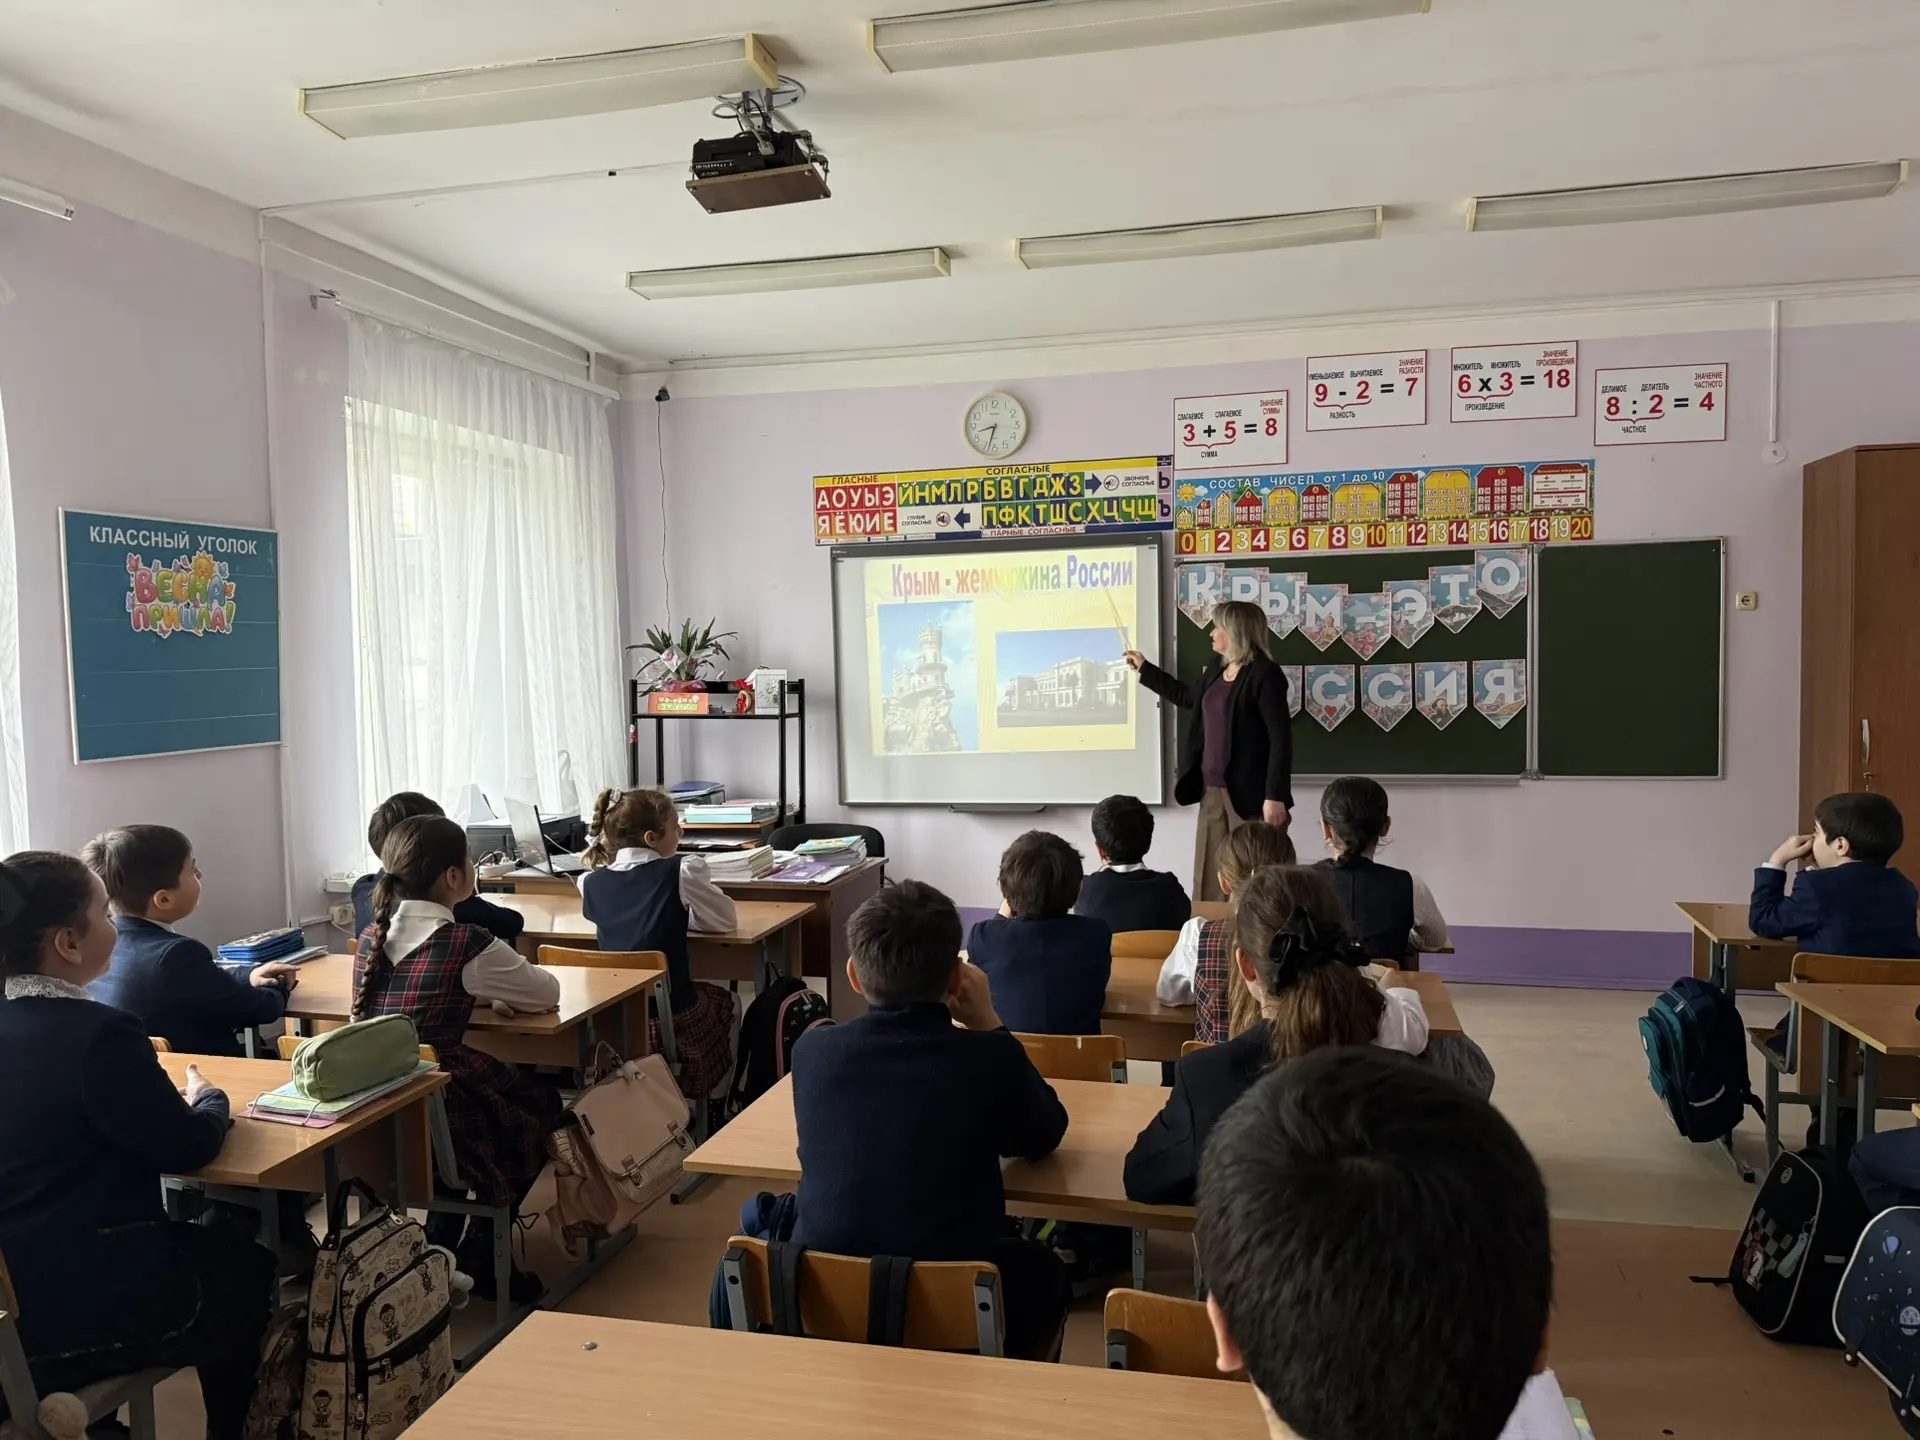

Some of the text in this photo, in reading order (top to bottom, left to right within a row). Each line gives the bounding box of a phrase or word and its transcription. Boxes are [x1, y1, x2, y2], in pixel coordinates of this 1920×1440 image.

[1543, 349, 1568, 357] ЗНАЧЕНИЕ
[1399, 358, 1424, 367] ЗНАЧЕНИЕ
[1453, 360, 1521, 371] МНОЖИТЕЛЬ МНОЖИТЕЛЬ
[1536, 357, 1575, 366] ПРОИЗВЕДЕНИЯ
[1308, 368, 1383, 381] УМЕНЬШАЕМОЕ ВЫЧИТАЕМОЕ
[1399, 366, 1424, 375] РАЗНОСТИ
[1694, 371, 1723, 380] ЗНАЧЕНИЕ
[1457, 373, 1471, 393] 6
[1499, 371, 1513, 391] 3
[1543, 368, 1570, 389] 18
[1694, 380, 1723, 389] ЧАСТНОГО
[1314, 383, 1328, 402] 9
[1356, 380, 1369, 400] 2
[1405, 377, 1419, 396] 7
[1601, 382, 1669, 394] ДЕЛИМОЕ ДЕЛИТЕЛЬ
[992, 400, 999, 408] 12
[1004, 401, 1007, 409] 1
[1260, 398, 1283, 407] ЗНАЧЕНИЕ
[1465, 401, 1505, 411] ПРОИЗВЕДЕНИЕ
[1606, 396, 1620, 416] 8
[1648, 394, 1663, 414] 2
[1699, 391, 1714, 411] 4
[981, 403, 987, 412] 11
[1262, 406, 1280, 415] СУММЫ
[973, 412, 981, 420] 10
[1010, 409, 1016, 418] 2
[1178, 409, 1242, 421] СЛАГАЕМОЕ СЛАГАЕМОЕ
[1329, 410, 1355, 419] РАЗНОСТЬ
[970, 423, 976, 432] 9
[1014, 421, 1020, 429] 3
[1183, 423, 1195, 441] 3
[1224, 420, 1236, 439] 5
[1265, 417, 1277, 436] 8
[1622, 424, 1646, 434] ЧАСТНОЕ
[974, 434, 980, 443] 8
[1010, 432, 1016, 440] 4
[983, 441, 988, 449] 7
[992, 444, 998, 452] 6
[1002, 440, 1008, 449] 5
[1201, 450, 1218, 458] СУММА
[986, 465, 1050, 476] СОГЛАСНЫЕ
[832, 475, 878, 485] ГЛАСНЫЕ
[1209, 470, 1385, 489] СОСТАВ ЧИСЕЛ от 1 до 10
[990, 526, 1076, 537] ПАРНЫЕ СОГЛАСНЫЕ
[1181, 518, 1591, 552] 0 1 2 3 4 5 6 7 8 9 10 11 12 13 14 15 16 17 18 19 20
[89, 525, 258, 556] КЛАССНЫЙ УГОЛОК
[892, 563, 940, 603] Крым
[956, 563, 1061, 601] жемчужина
[1067, 554, 1133, 588] России
[134, 567, 226, 604] ВЕСНА
[1394, 557, 1522, 620] ЭТО
[132, 600, 236, 634] ПРИШЛА!
